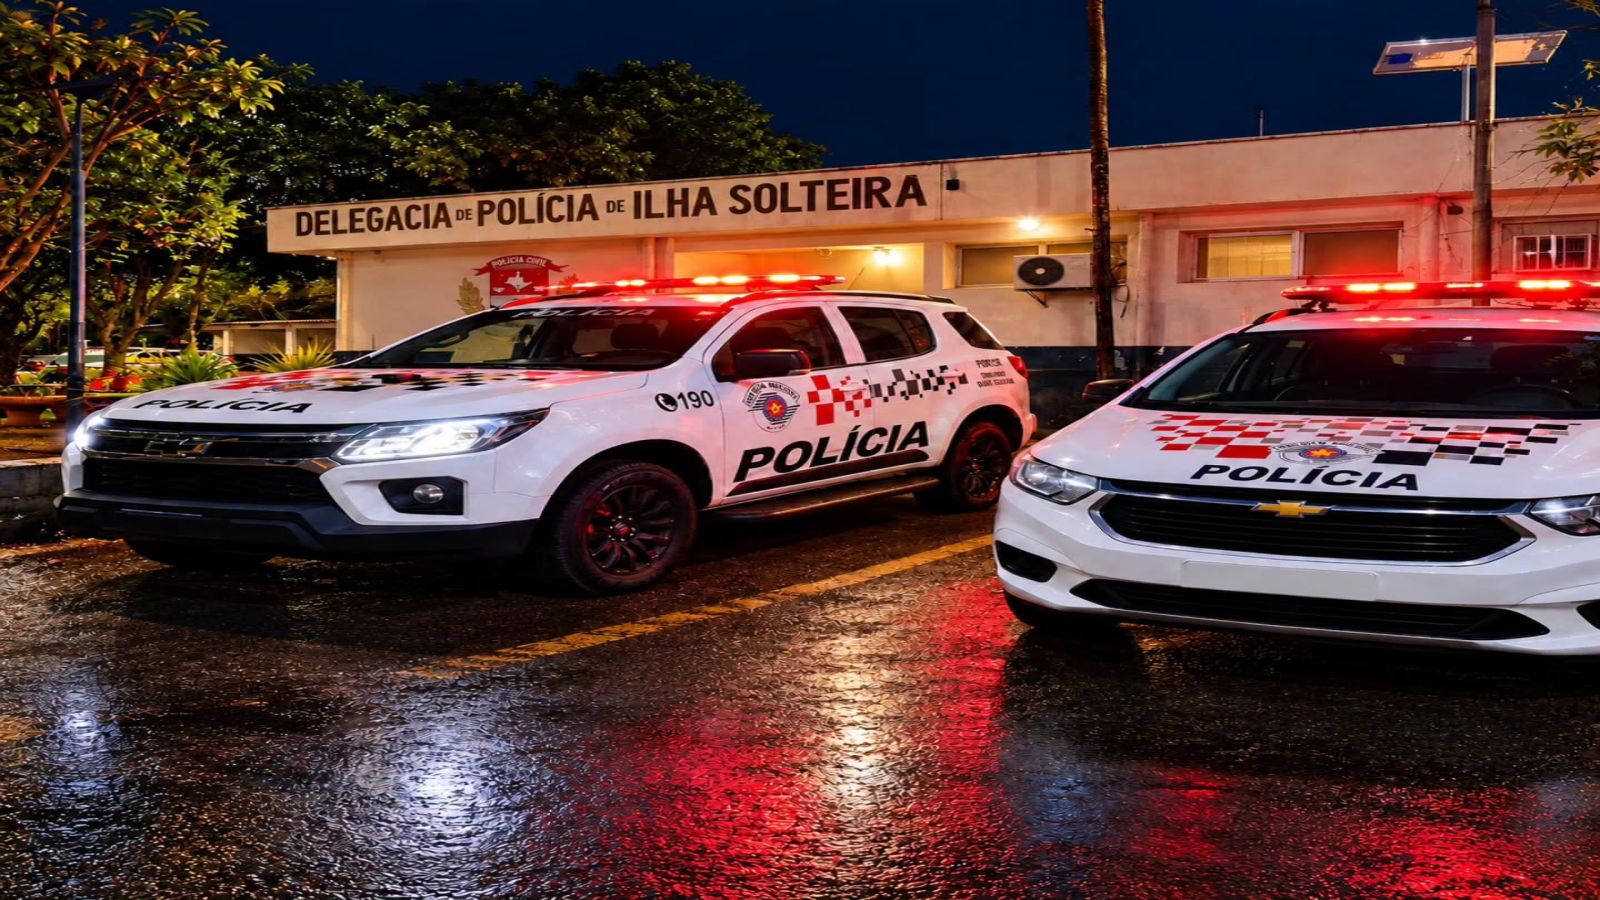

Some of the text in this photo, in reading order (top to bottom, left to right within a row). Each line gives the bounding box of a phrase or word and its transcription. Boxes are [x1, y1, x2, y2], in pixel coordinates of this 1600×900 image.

[295, 174, 928, 237] DELEGACIA DE POLÍCIA DE ILHA SOLTEIRA
[526, 256, 547, 267] CIVIL
[677, 390, 715, 410] 190
[733, 420, 929, 483] POLÍCIA
[1190, 465, 1419, 491] POLÍCIA
